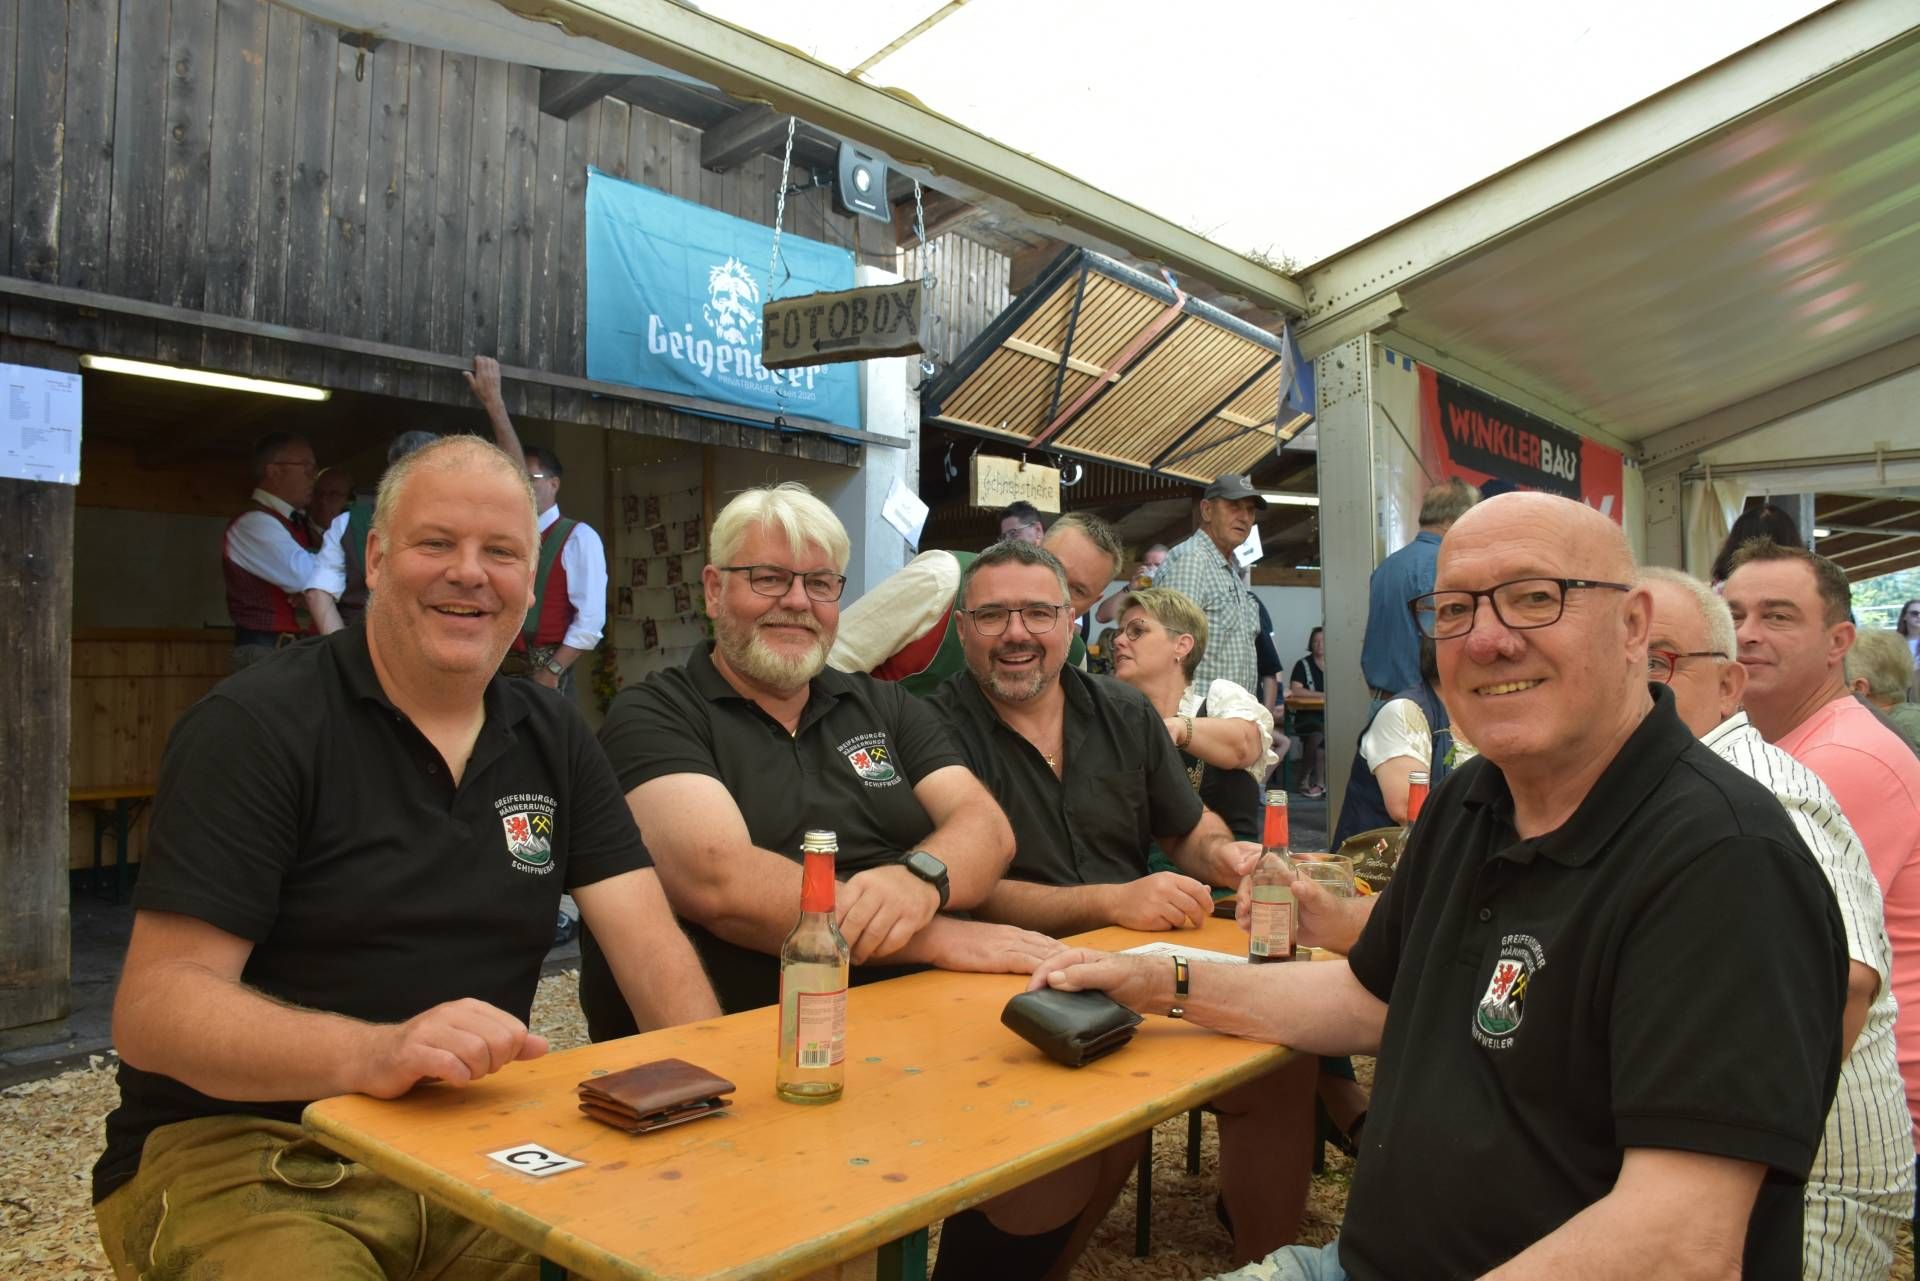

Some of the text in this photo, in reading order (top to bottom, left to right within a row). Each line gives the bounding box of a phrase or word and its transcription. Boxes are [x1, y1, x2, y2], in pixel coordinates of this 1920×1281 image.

[764, 288, 918, 352] FOTOBOX
[717, 374, 782, 395] PRIVATBRAUER
[494, 793, 558, 809] GREIFENBURGER
[499, 803, 556, 817] MÄNNERRUNDE
[505, 1150, 568, 1172] C1
